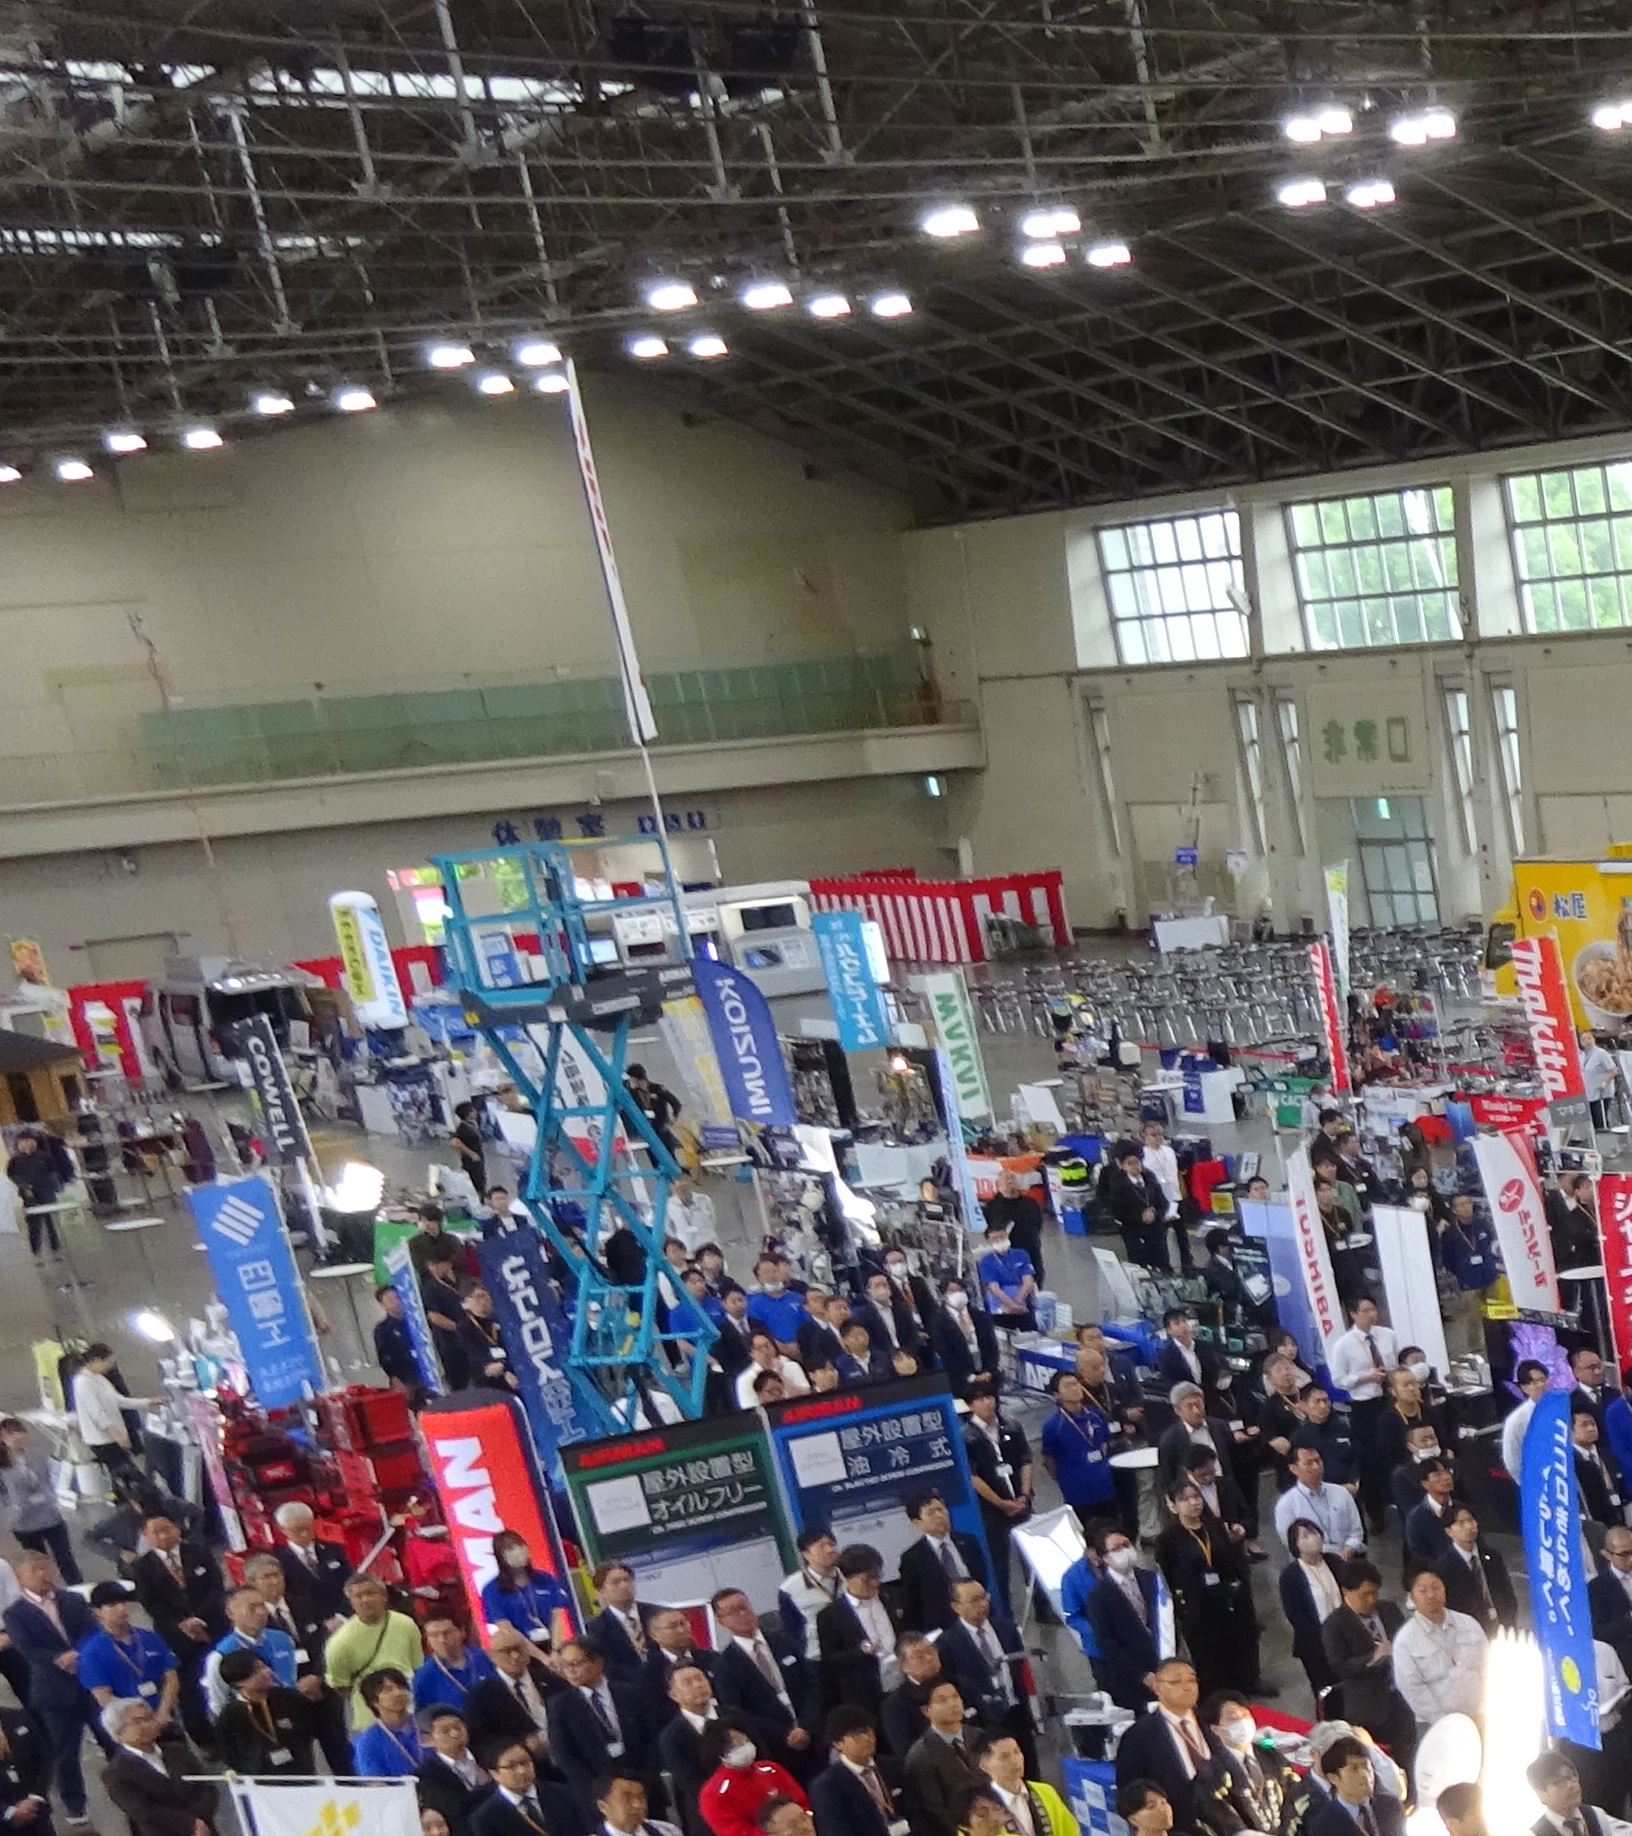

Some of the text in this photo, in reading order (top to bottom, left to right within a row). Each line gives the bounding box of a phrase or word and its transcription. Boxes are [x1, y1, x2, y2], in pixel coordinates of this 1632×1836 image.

[1511, 940, 1567, 1101] makita
[248, 1036, 295, 1152] COWELL
[652, 1482, 764, 1520] オイルフリー
